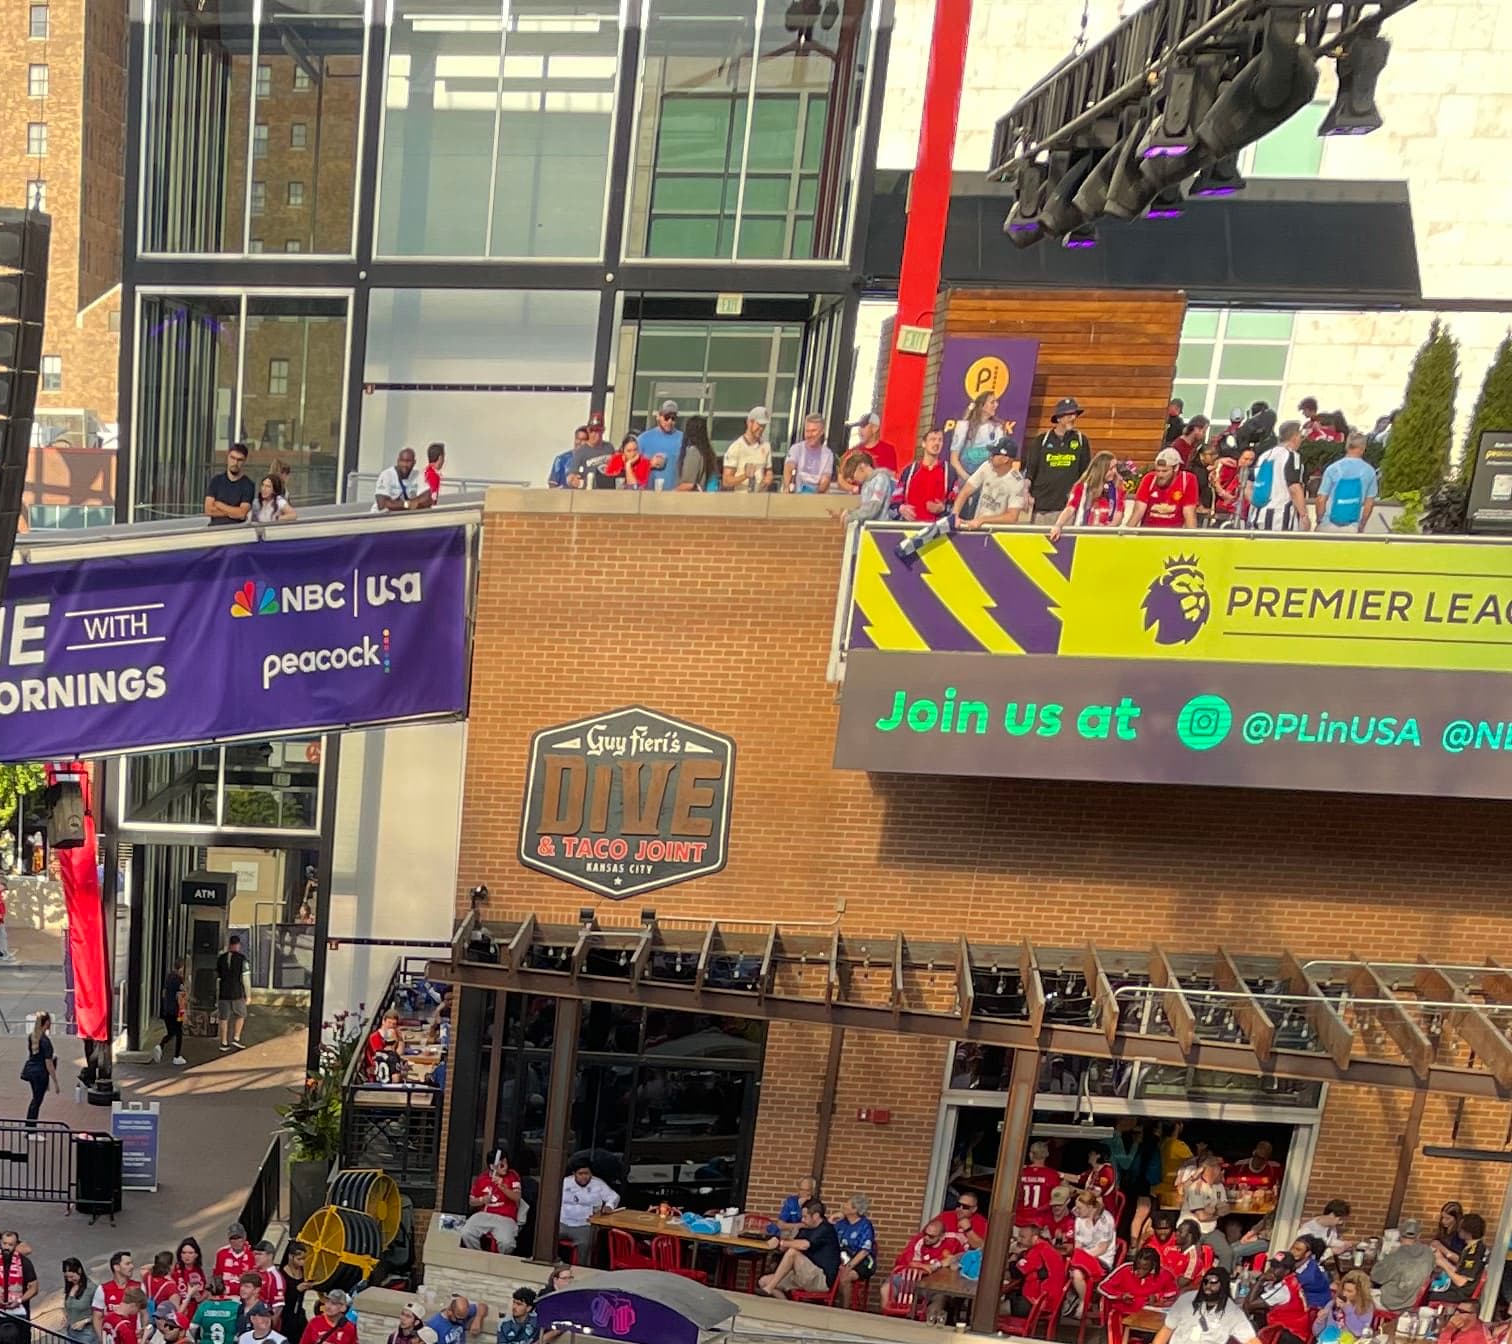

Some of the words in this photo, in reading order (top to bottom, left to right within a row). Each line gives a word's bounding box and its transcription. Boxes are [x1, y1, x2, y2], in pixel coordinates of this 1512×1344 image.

[282, 581, 346, 614] NBC
[1226, 585, 1414, 622] PREMIER
[1424, 591, 1512, 626] LEA
[83, 613, 149, 641] WITH
[263, 635, 382, 690] peacock
[876, 687, 987, 735] Join
[1004, 702, 1064, 738] us
[1077, 698, 1140, 741] at
[1241, 711, 1422, 747] @PLinUSA
[586, 725, 627, 757] Guy
[536, 754, 723, 837] DIVE
[538, 835, 556, 858] &
[563, 836, 629, 861] TACO
[634, 839, 708, 864] JOINT
[586, 862, 625, 874] KANSAS
[629, 863, 654, 875] CITY
[194, 889, 216, 899] ATM
[1023, 1184, 1041, 1208] 11
